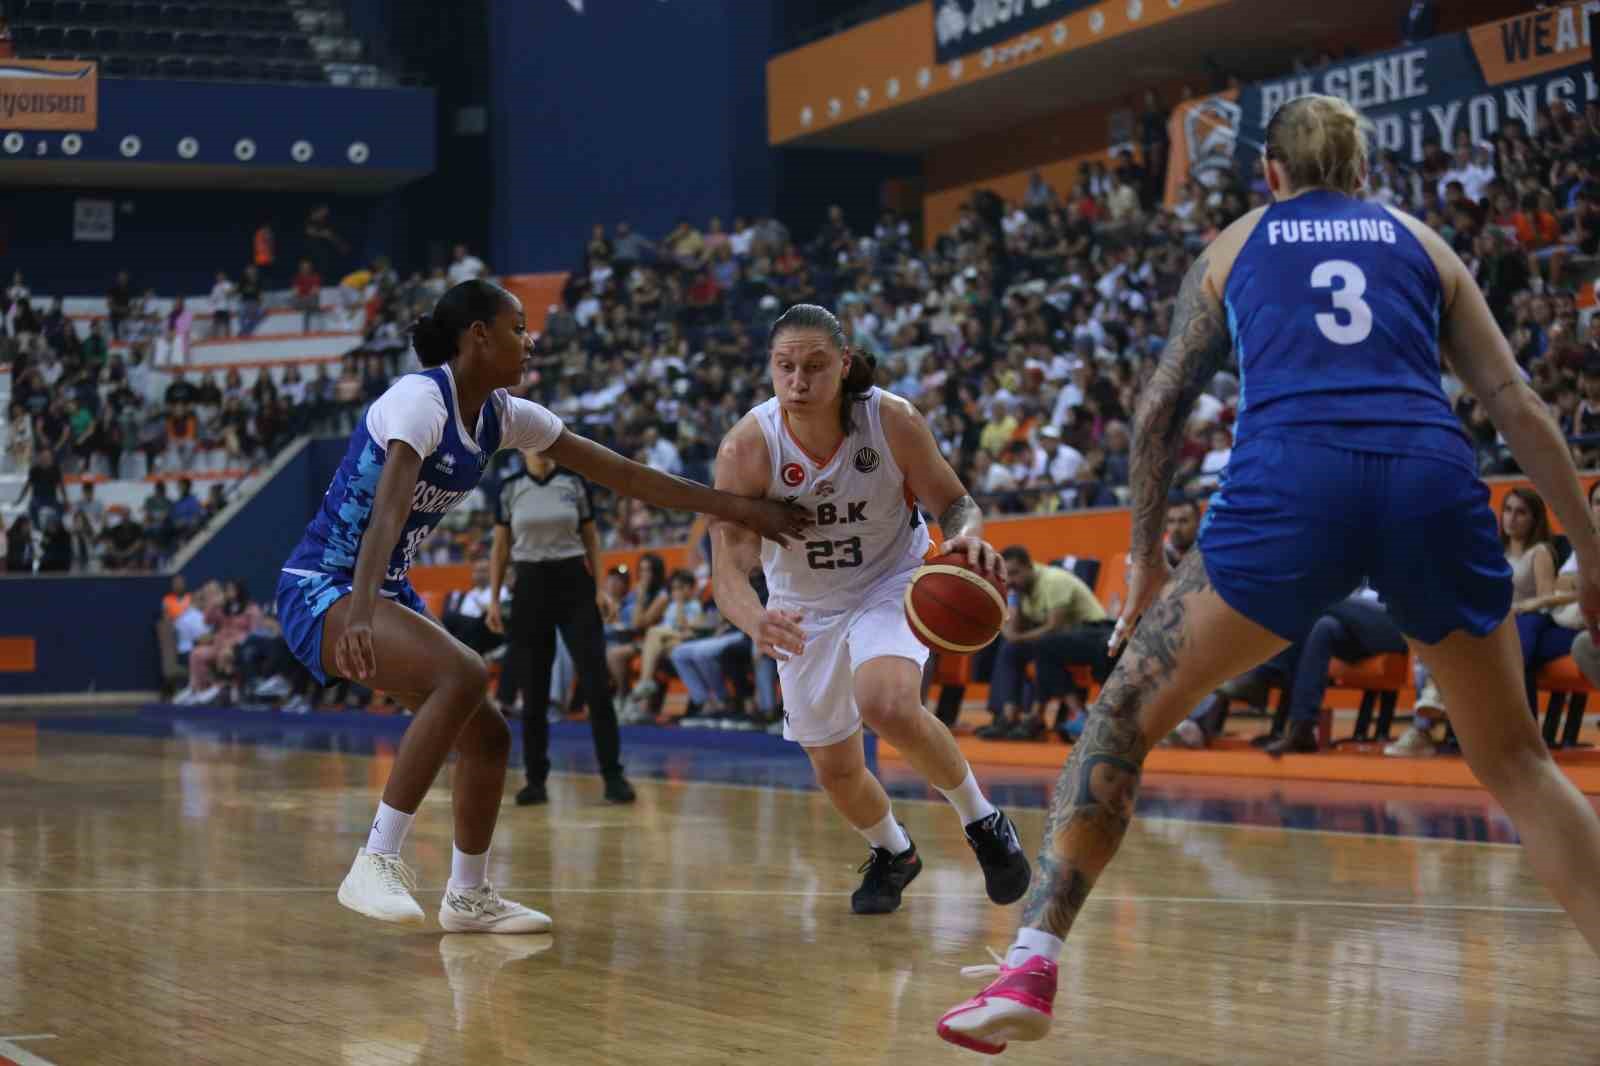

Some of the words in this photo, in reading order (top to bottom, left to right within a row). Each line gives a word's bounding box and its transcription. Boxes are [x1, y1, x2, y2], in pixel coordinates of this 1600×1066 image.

[0, 94, 86, 118] yonsun
[1267, 218, 1397, 246] FUEHRING
[1310, 259, 1373, 345] 3
[805, 536, 863, 570] 23
